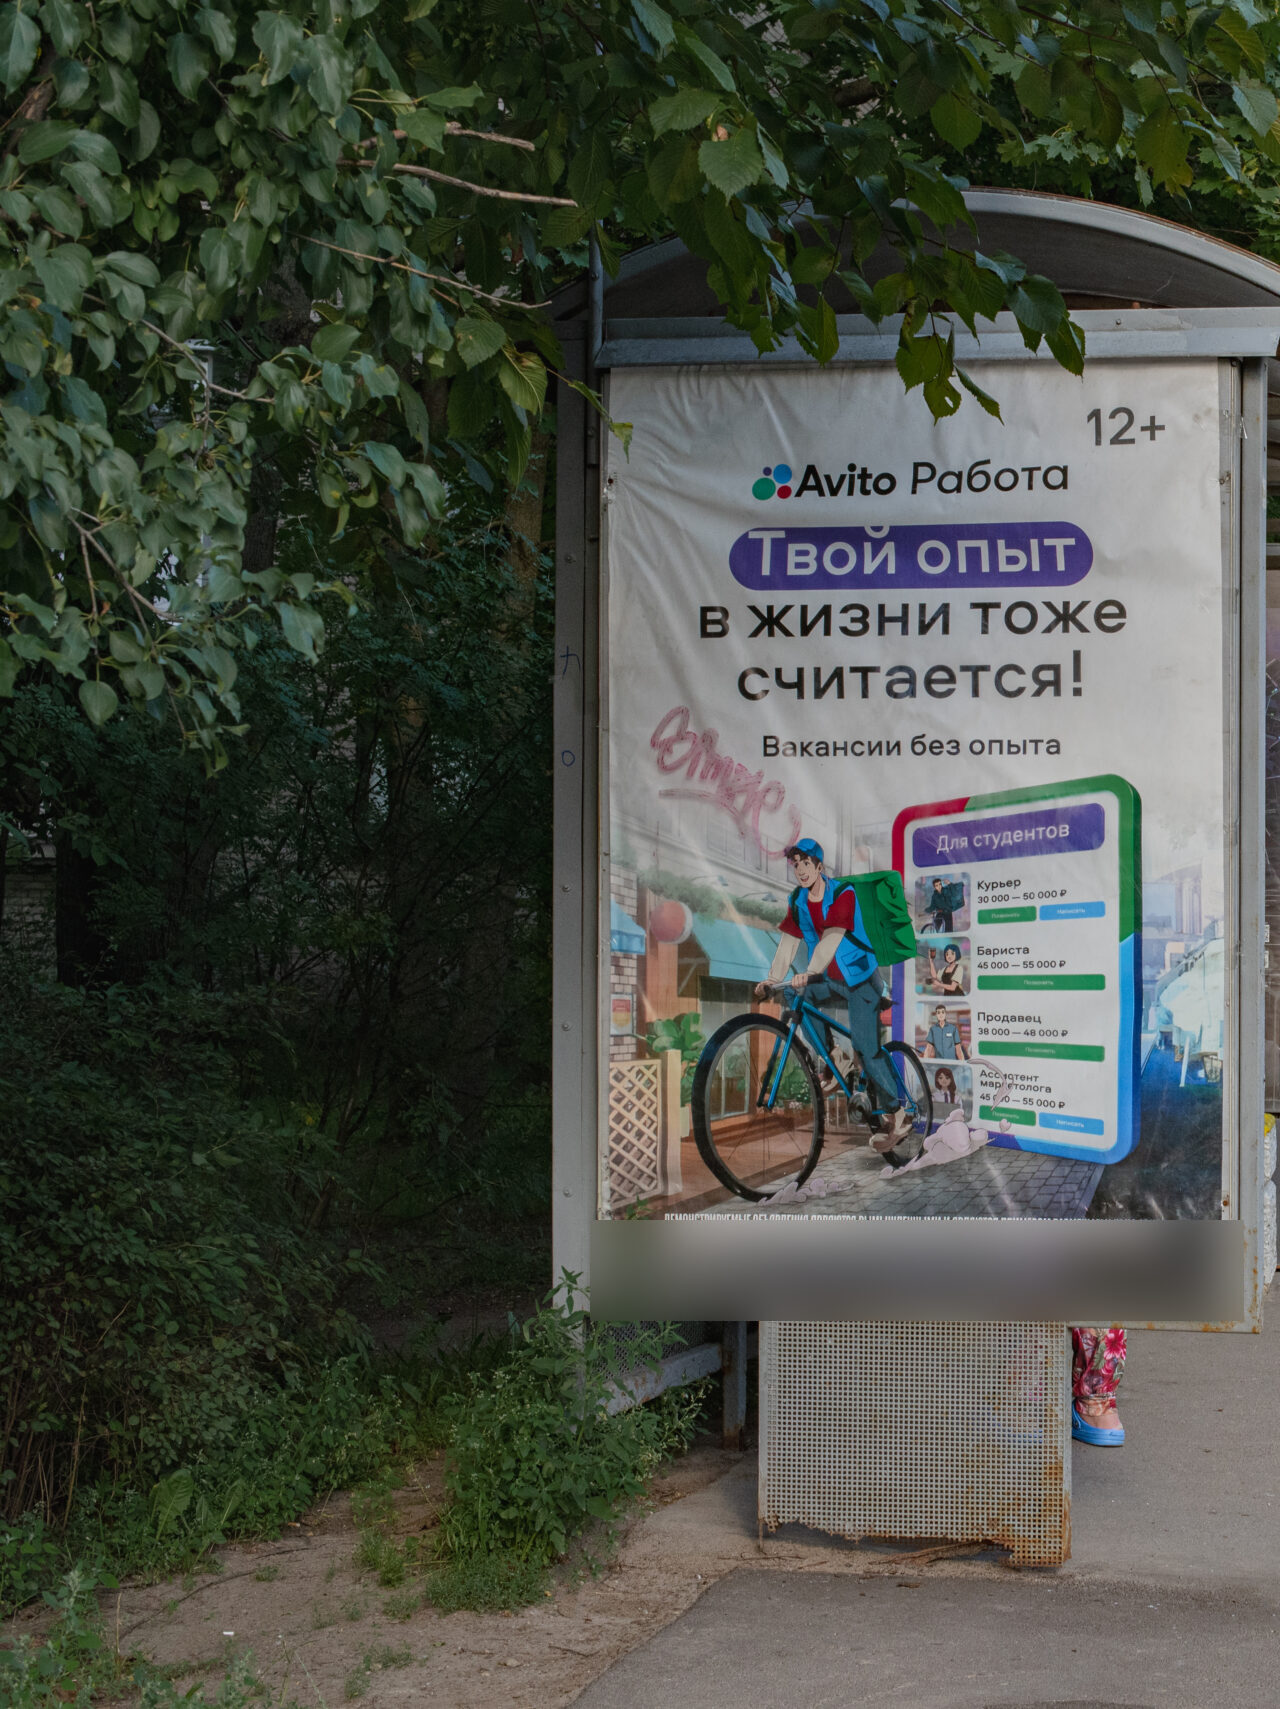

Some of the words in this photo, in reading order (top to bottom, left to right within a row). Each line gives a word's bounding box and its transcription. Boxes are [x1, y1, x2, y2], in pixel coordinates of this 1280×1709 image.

[1086, 406, 1166, 446] 12+
[794, 462, 897, 498] Avito
[911, 458, 1069, 495] Работа
[747, 525, 897, 577] Твой
[917, 537, 1076, 575] опыт
[700, 604, 730, 639] в
[747, 602, 951, 638] жизни
[970, 598, 1127, 635] тоже
[737, 649, 1083, 701] считается!
[762, 734, 901, 758] Вакансии
[910, 734, 960, 756] без
[968, 736, 1062, 757] опыта
[936, 835, 968, 855] Для
[973, 824, 1070, 849] студентов
[977, 879, 1022, 892] Курьер
[977, 895, 990, 904] 30
[991, 894, 1010, 903] 000
[1023, 892, 1035, 901] 50
[1037, 890, 1058, 899] 000
[977, 946, 1030, 957] Бариста
[977, 961, 989, 970] 45
[991, 961, 1010, 969] 000
[1022, 960, 1035, 969] 55
[1036, 960, 1057, 969] 000
[977, 1012, 1042, 1025] Продавец
[978, 1027, 990, 1036] 38
[991, 1027, 1010, 1036] 000
[1023, 1029, 1036, 1037] 48
[1038, 1029, 1059, 1037] 000
[980, 1092, 991, 1101] 45
[1022, 1097, 1034, 1106] 55
[1036, 1098, 1056, 1108] 000
